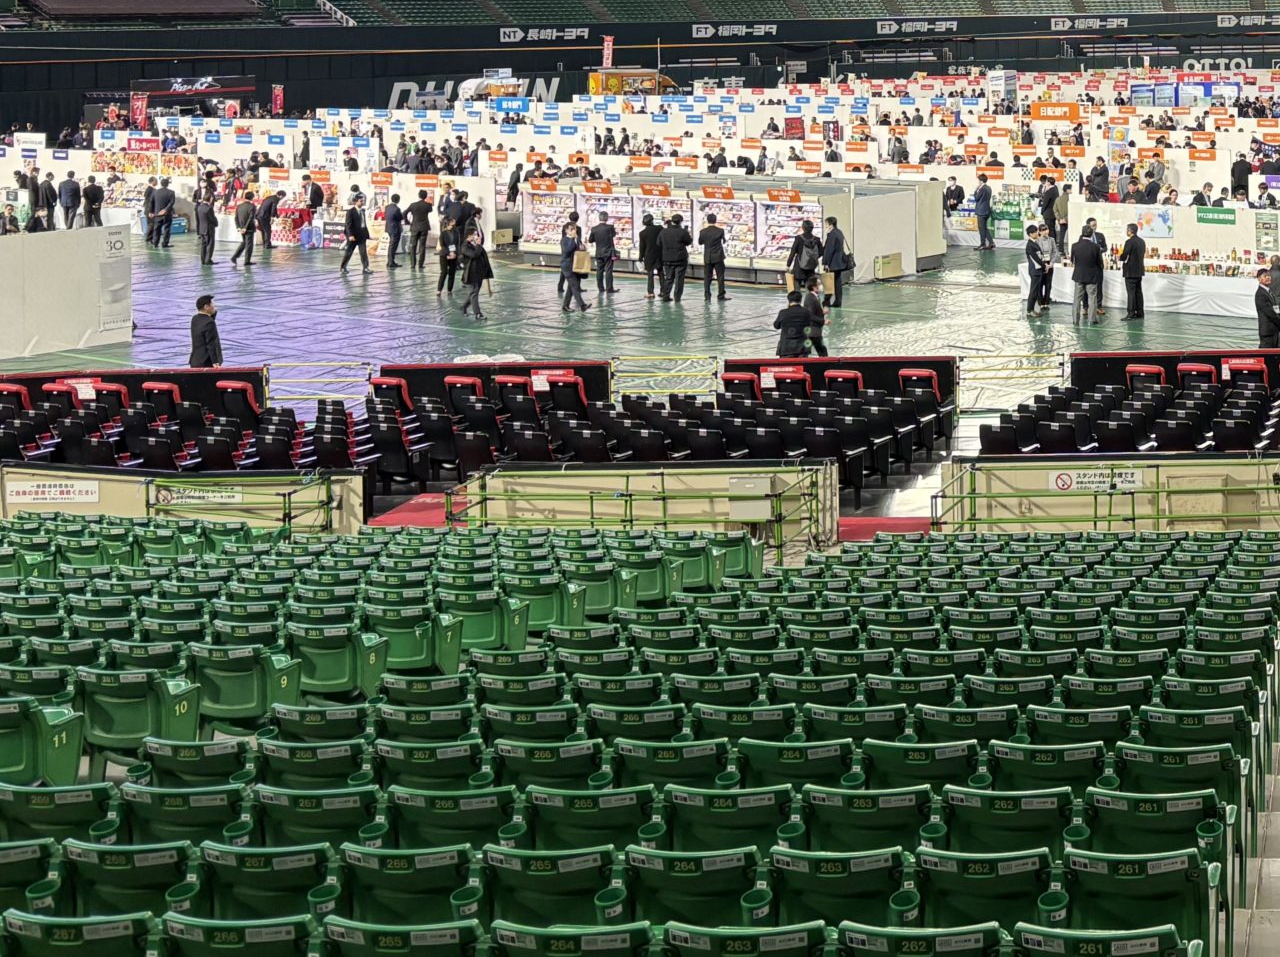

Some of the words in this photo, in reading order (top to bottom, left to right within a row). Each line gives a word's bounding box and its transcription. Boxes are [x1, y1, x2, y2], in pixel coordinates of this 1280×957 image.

[880, 23, 893, 32] FT
[900, 21, 958, 33] 福岡トヨタ
[1054, 20, 1066, 29] FT
[1073, 17, 1129, 29] 福岡トヨタ
[1219, 17, 1232, 26] FT
[502, 31, 518, 40] NT
[526, 28, 589, 41] 長崎トヨタ
[695, 26, 710, 36] FT
[717, 25, 778, 37] 福岡トヨタ
[1183, 57, 1253, 70] OTTO!
[514, 614, 520, 625] 6
[445, 630, 452, 643] 7
[369, 652, 376, 664] 8
[280, 675, 288, 688] 9
[174, 700, 188, 716] 10
[52, 732, 67, 748] 11
[298, 799, 317, 808] 267
[434, 799, 454, 809] 266
[574, 799, 594, 808] 265
[713, 798, 733, 807] 264
[852, 799, 872, 808] 263
[994, 800, 1014, 809] 262
[1139, 802, 1158, 812] 261
[244, 857, 266, 867] 267
[386, 859, 408, 869] 266
[529, 860, 551, 870] 265
[673, 861, 695, 871] 264
[819, 862, 842, 873] 263
[968, 863, 990, 873] 262
[1118, 864, 1140, 874] 261
[53, 928, 76, 940] 267
[214, 931, 239, 942] 266
[378, 936, 402, 947] 265
[549, 940, 575, 951] 264
[726, 940, 752, 952] 263
[902, 941, 927, 953] 262
[1079, 943, 1103, 954] 261
